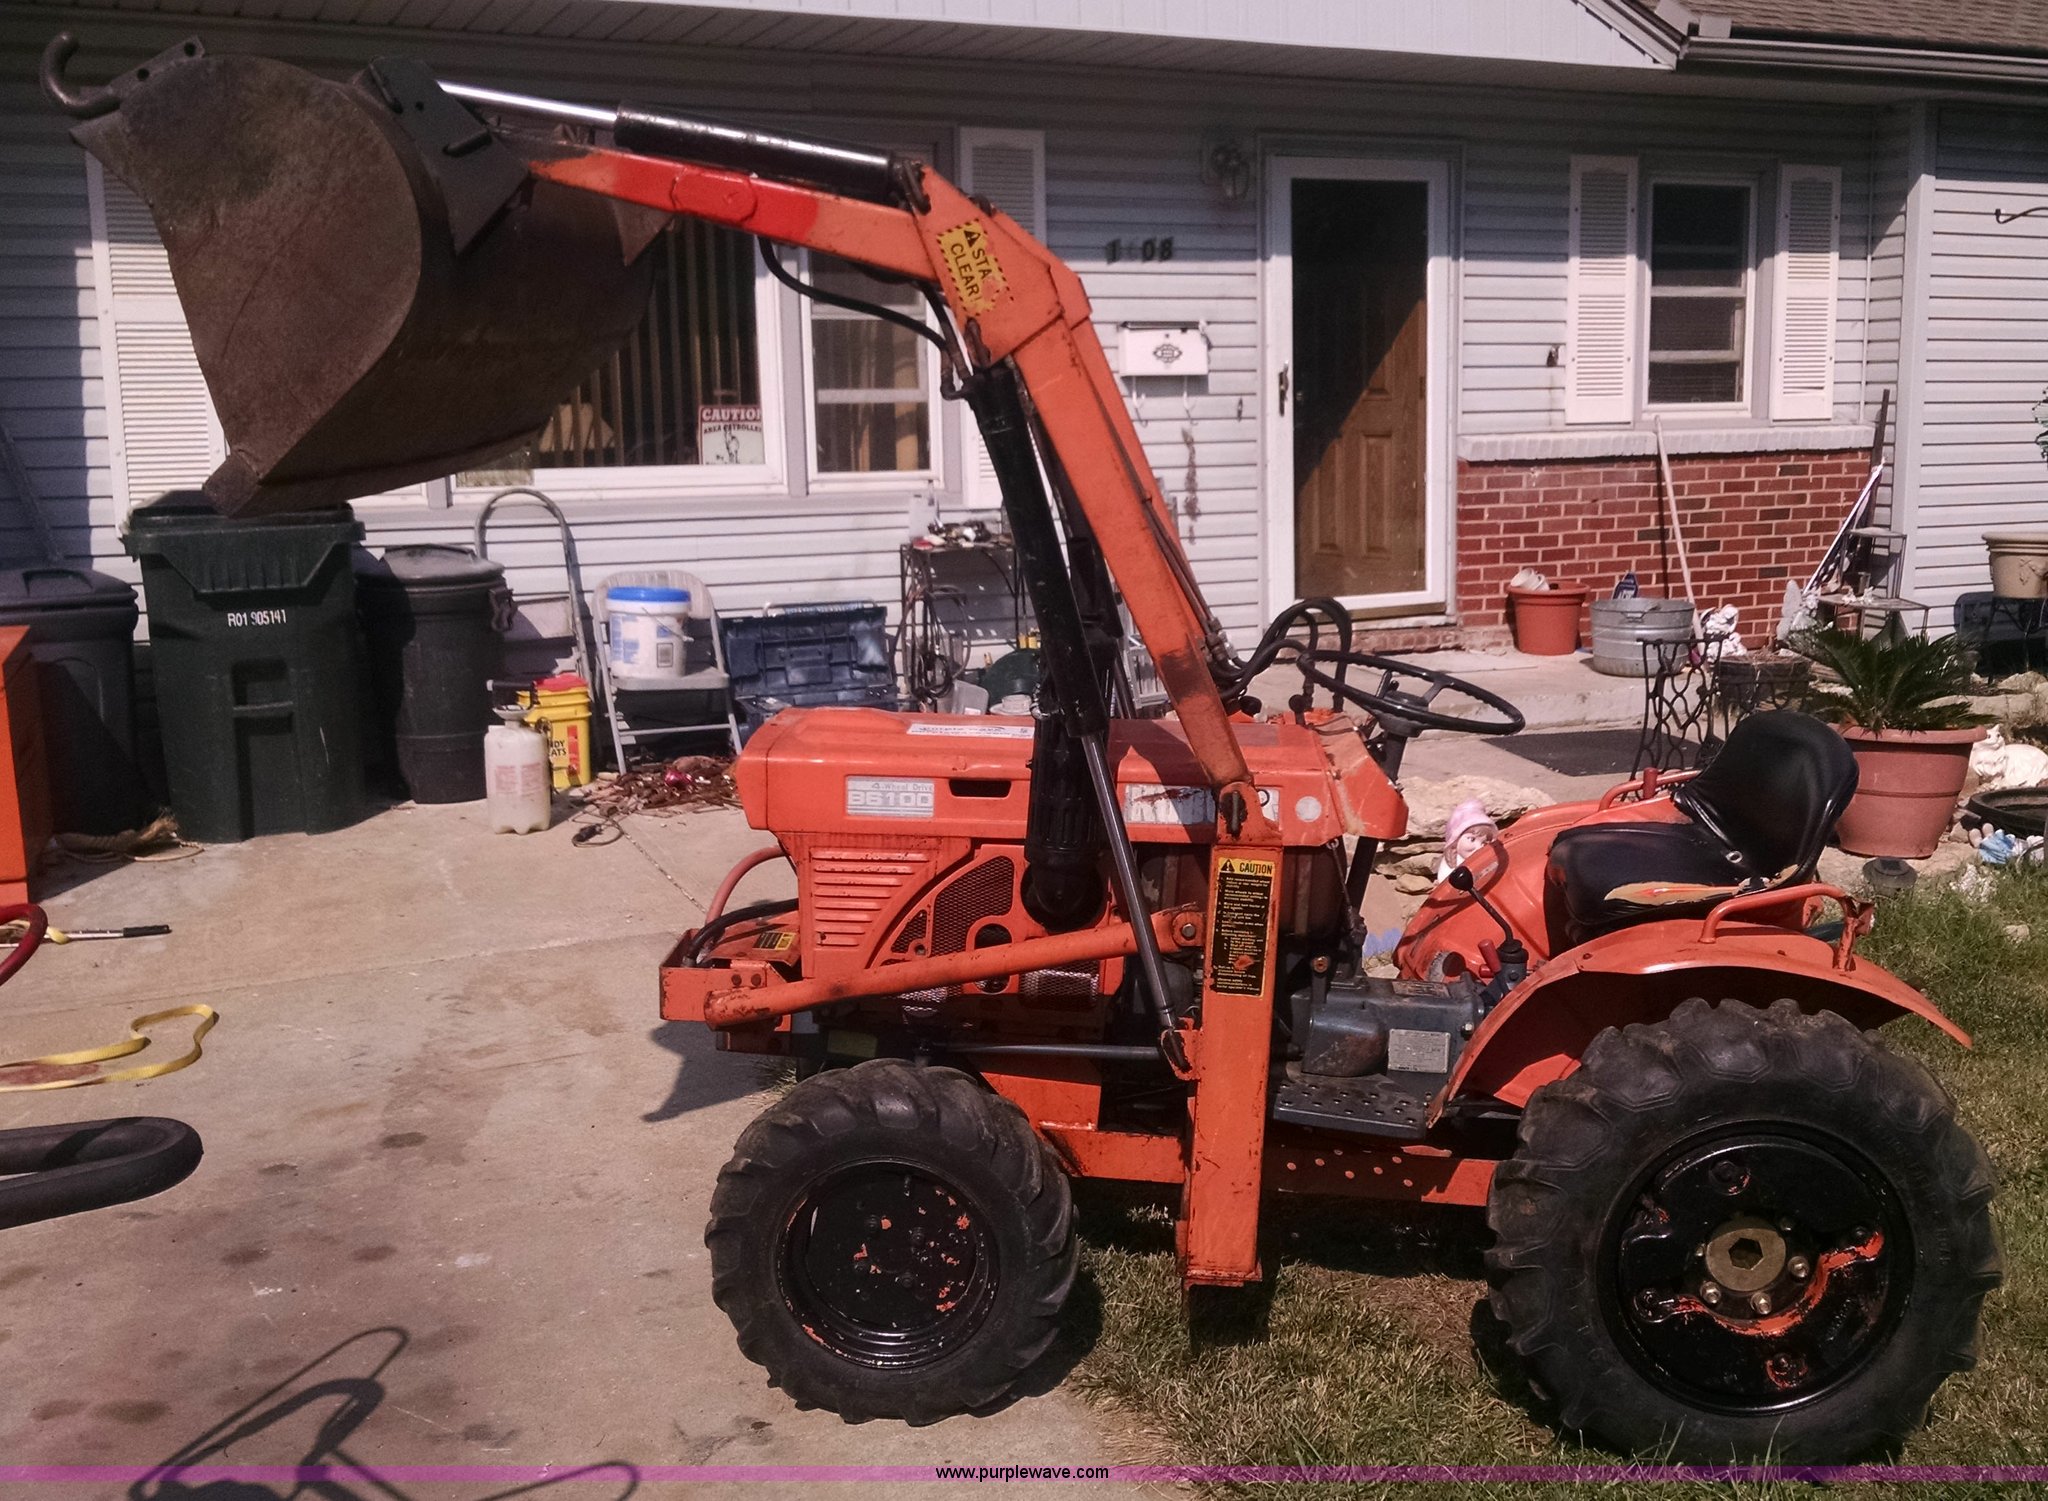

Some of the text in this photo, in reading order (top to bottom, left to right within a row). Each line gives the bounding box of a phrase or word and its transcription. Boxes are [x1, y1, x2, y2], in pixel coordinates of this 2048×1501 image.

[950, 243, 983, 302] CLEAR!
[550, 748, 567, 757] ATS
[1239, 862, 1273, 875] CAUTION
